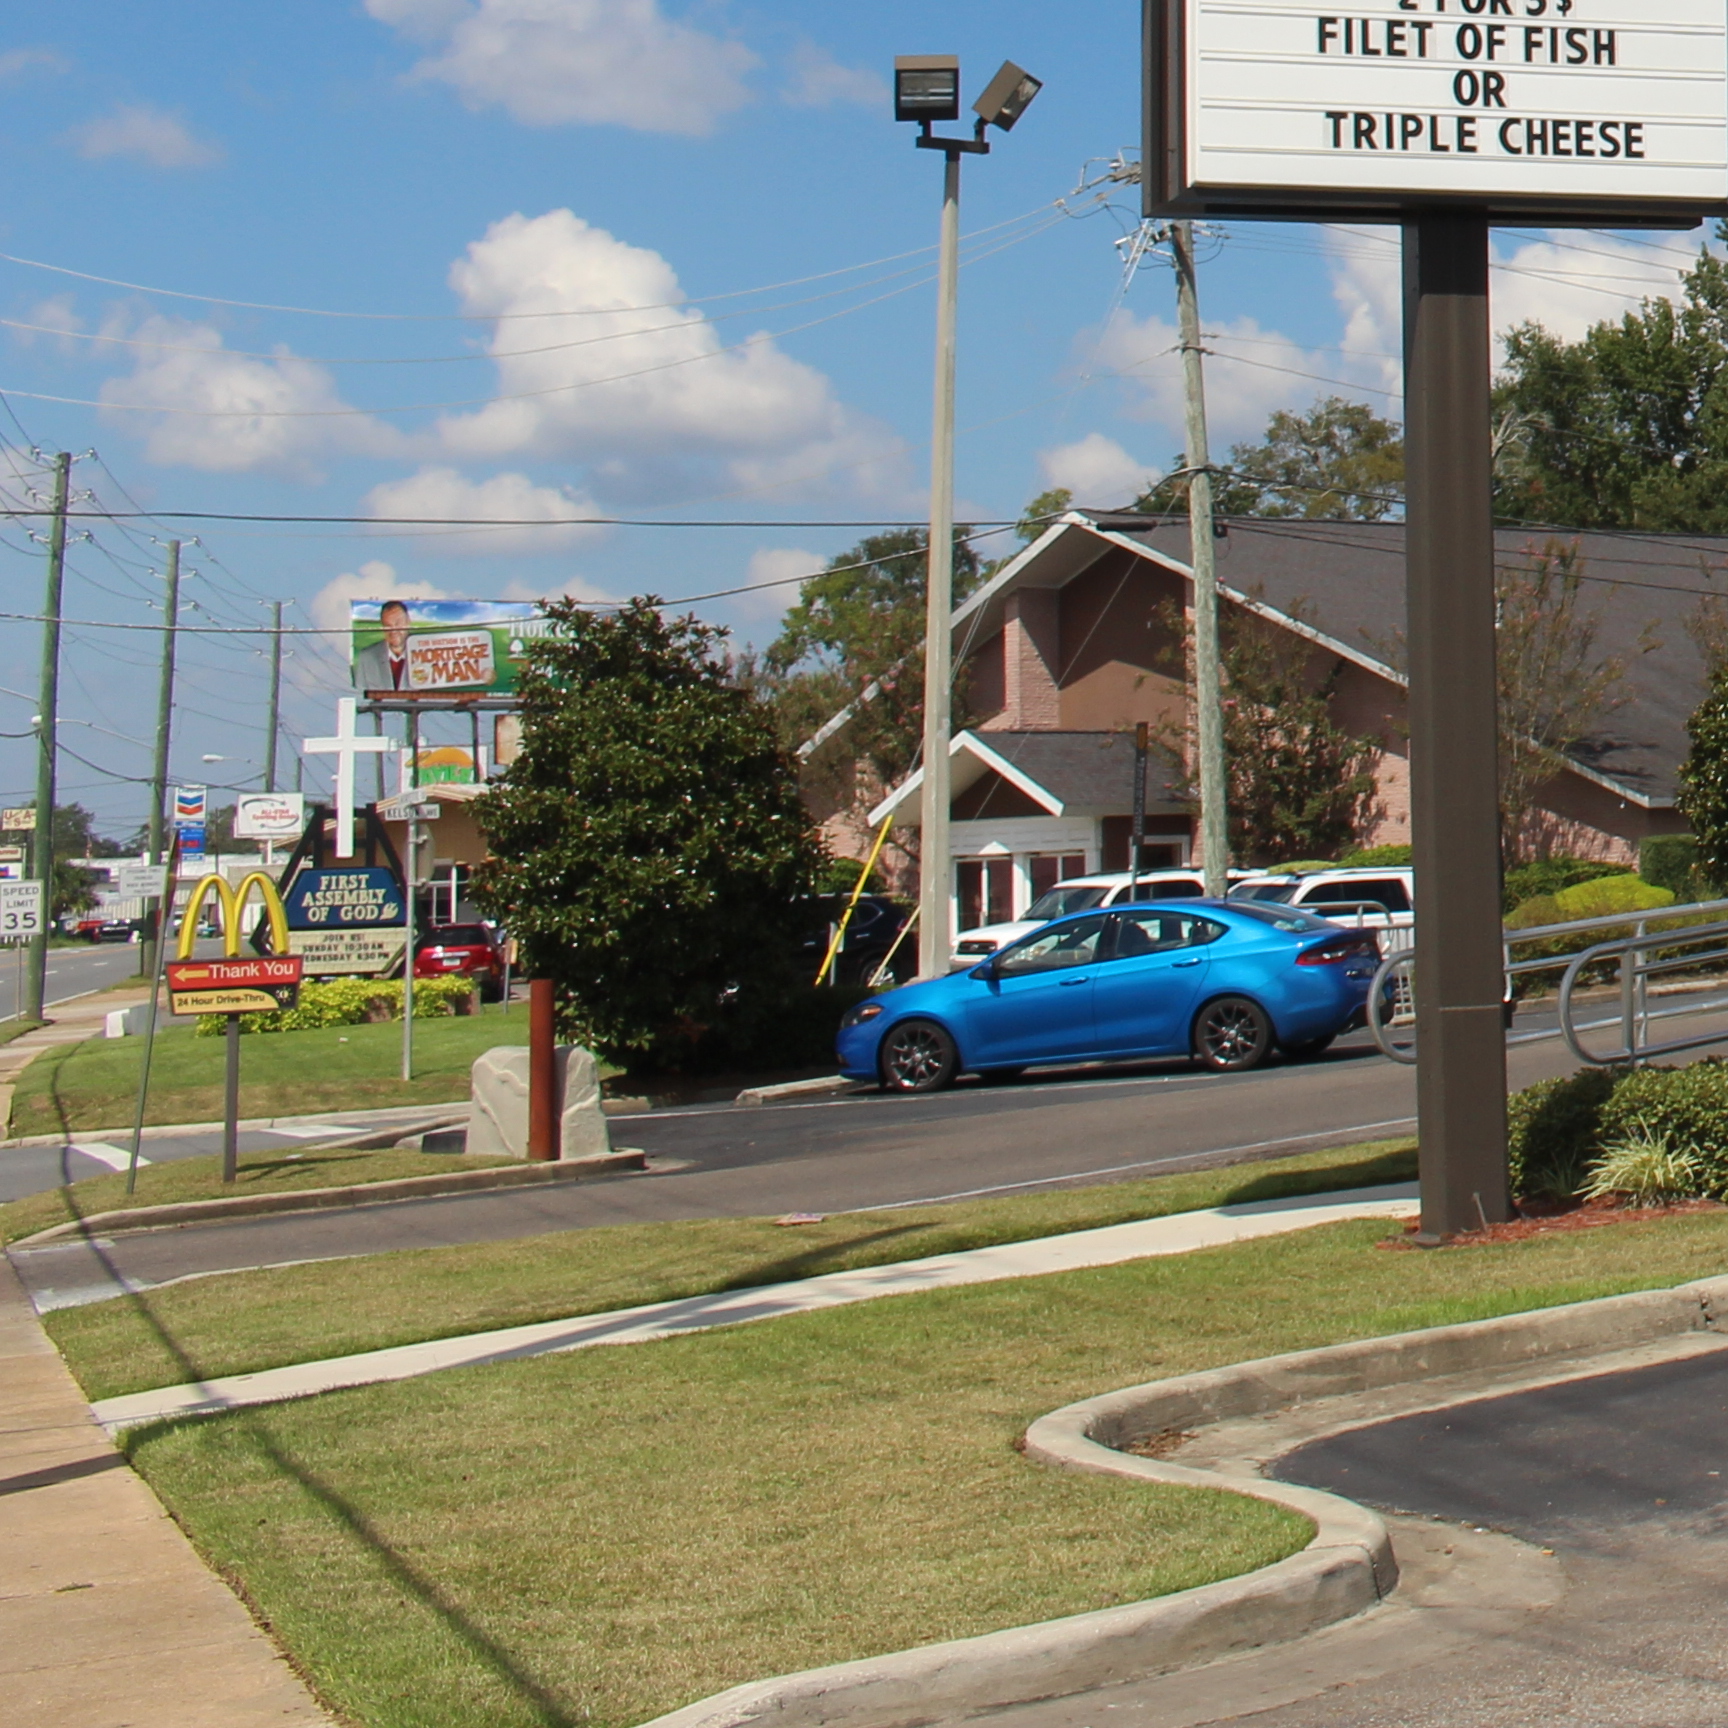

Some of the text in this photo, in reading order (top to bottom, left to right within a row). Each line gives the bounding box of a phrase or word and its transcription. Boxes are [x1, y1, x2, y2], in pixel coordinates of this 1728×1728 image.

[1318, 16, 1616, 66] FILET OF FISH
[1453, 70, 1507, 108] OR
[1325, 111, 1645, 159] TRIPLE CHEESE
[411, 643, 490, 664] MORTGAGE
[431, 659, 482, 684] MAN
[320, 874, 370, 890] FIRST
[3, 886, 39, 896] SPEED
[302, 888, 387, 907] ASSEMBLY
[6, 899, 36, 909] LIMIT
[5, 912, 37, 929] 35
[308, 905, 379, 922] OF GOD
[323, 934, 345, 942] JOIN
[303, 942, 384, 953] SUNDAY 10:30 AM
[305, 953, 352, 962] EDNESDAY
[209, 961, 294, 979] Thank You
[177, 993, 266, 1007] 24 Hour Drive-Thru
